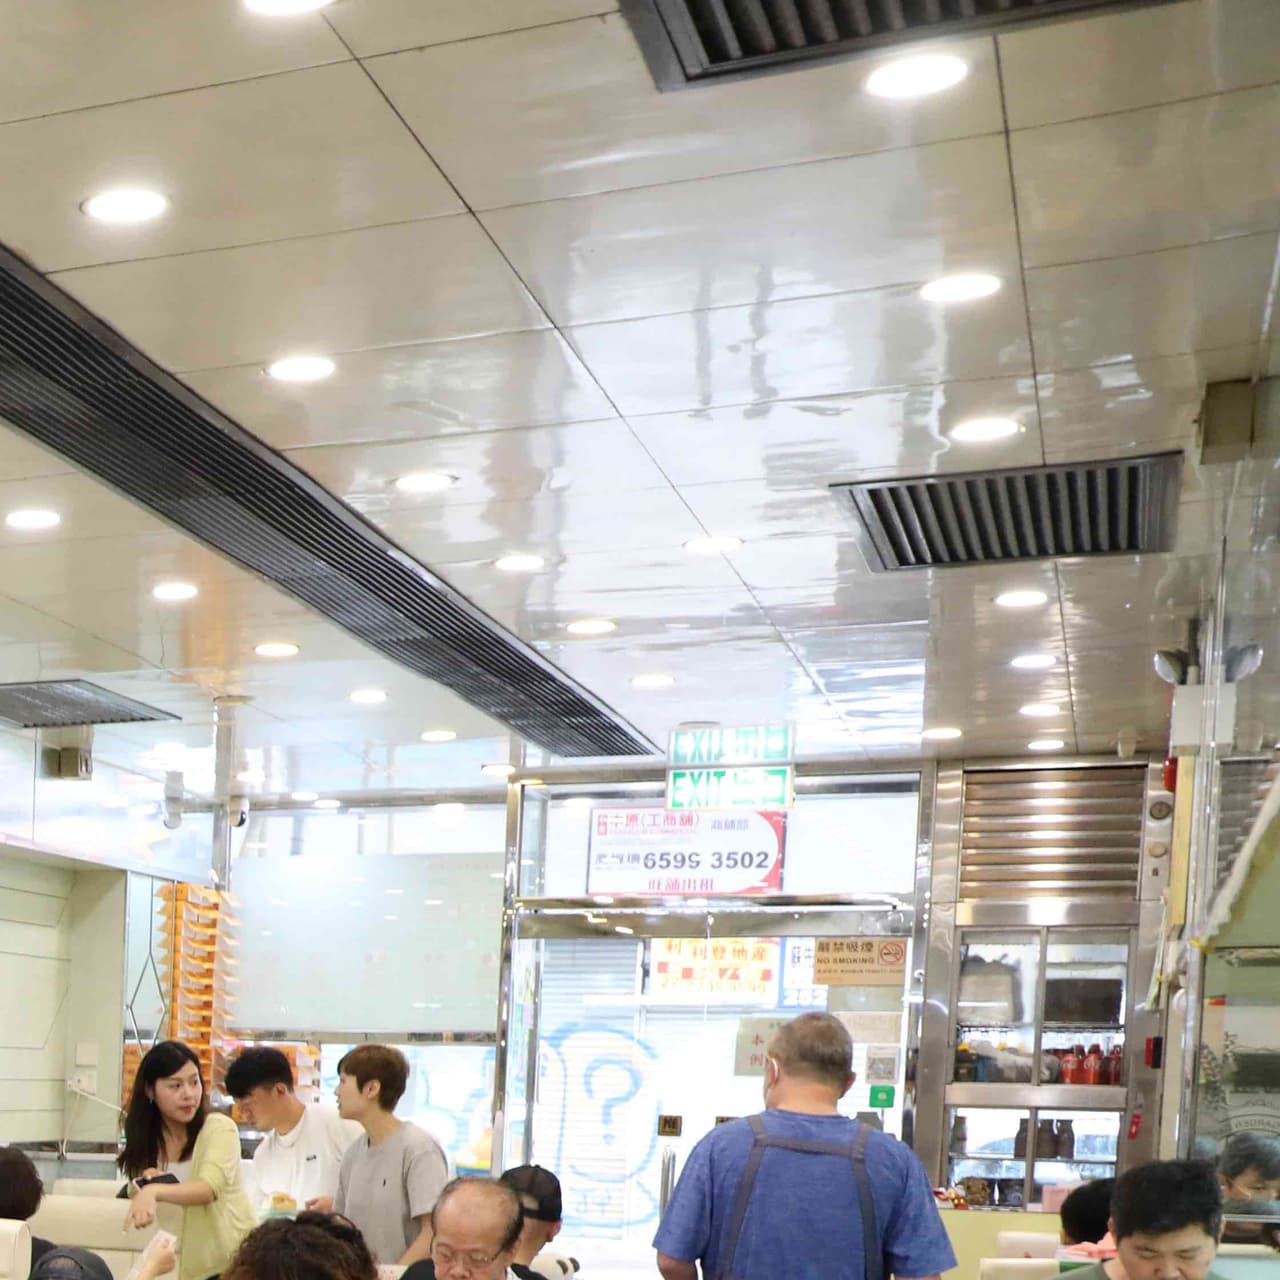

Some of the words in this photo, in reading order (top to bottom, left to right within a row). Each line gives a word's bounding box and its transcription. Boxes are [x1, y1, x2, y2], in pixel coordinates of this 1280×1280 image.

[672, 771, 726, 808] EXIT
[710, 851, 769, 869] 3502
[816, 957, 830, 965] NO
[832, 957, 875, 965] SMOKING
